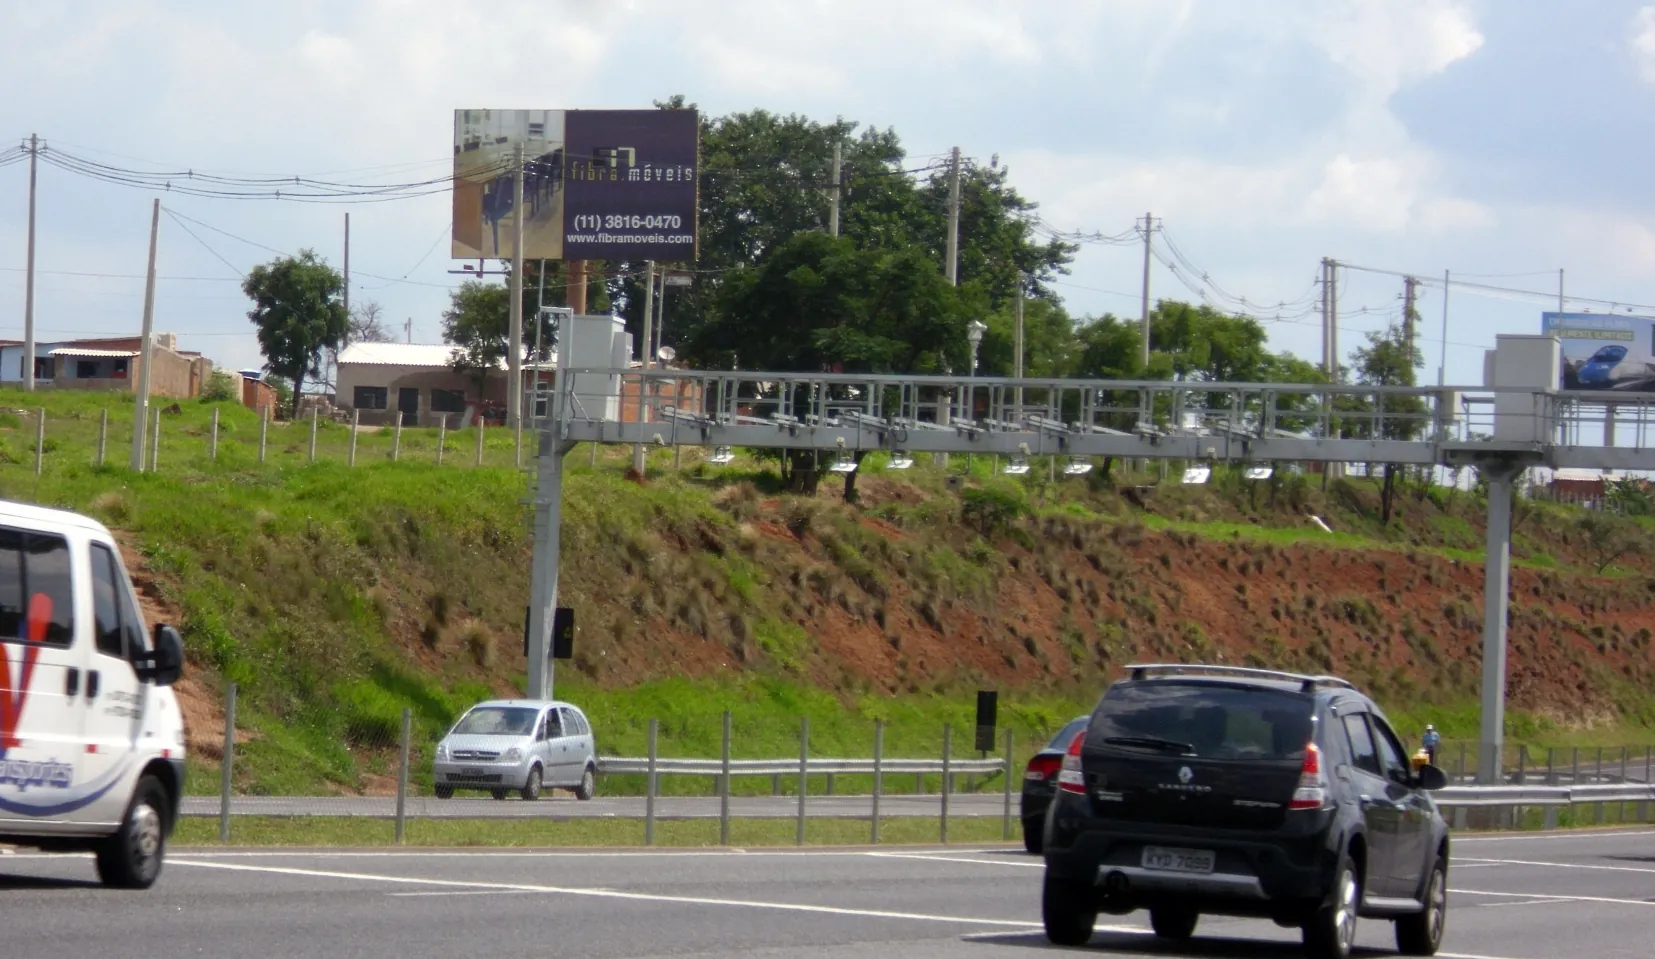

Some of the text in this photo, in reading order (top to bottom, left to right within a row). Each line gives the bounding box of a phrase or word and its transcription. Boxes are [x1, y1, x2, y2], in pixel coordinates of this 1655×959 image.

[574, 215, 681, 231] (11) 3816-0470
[567, 233, 693, 244] www.fibramoveis.com
